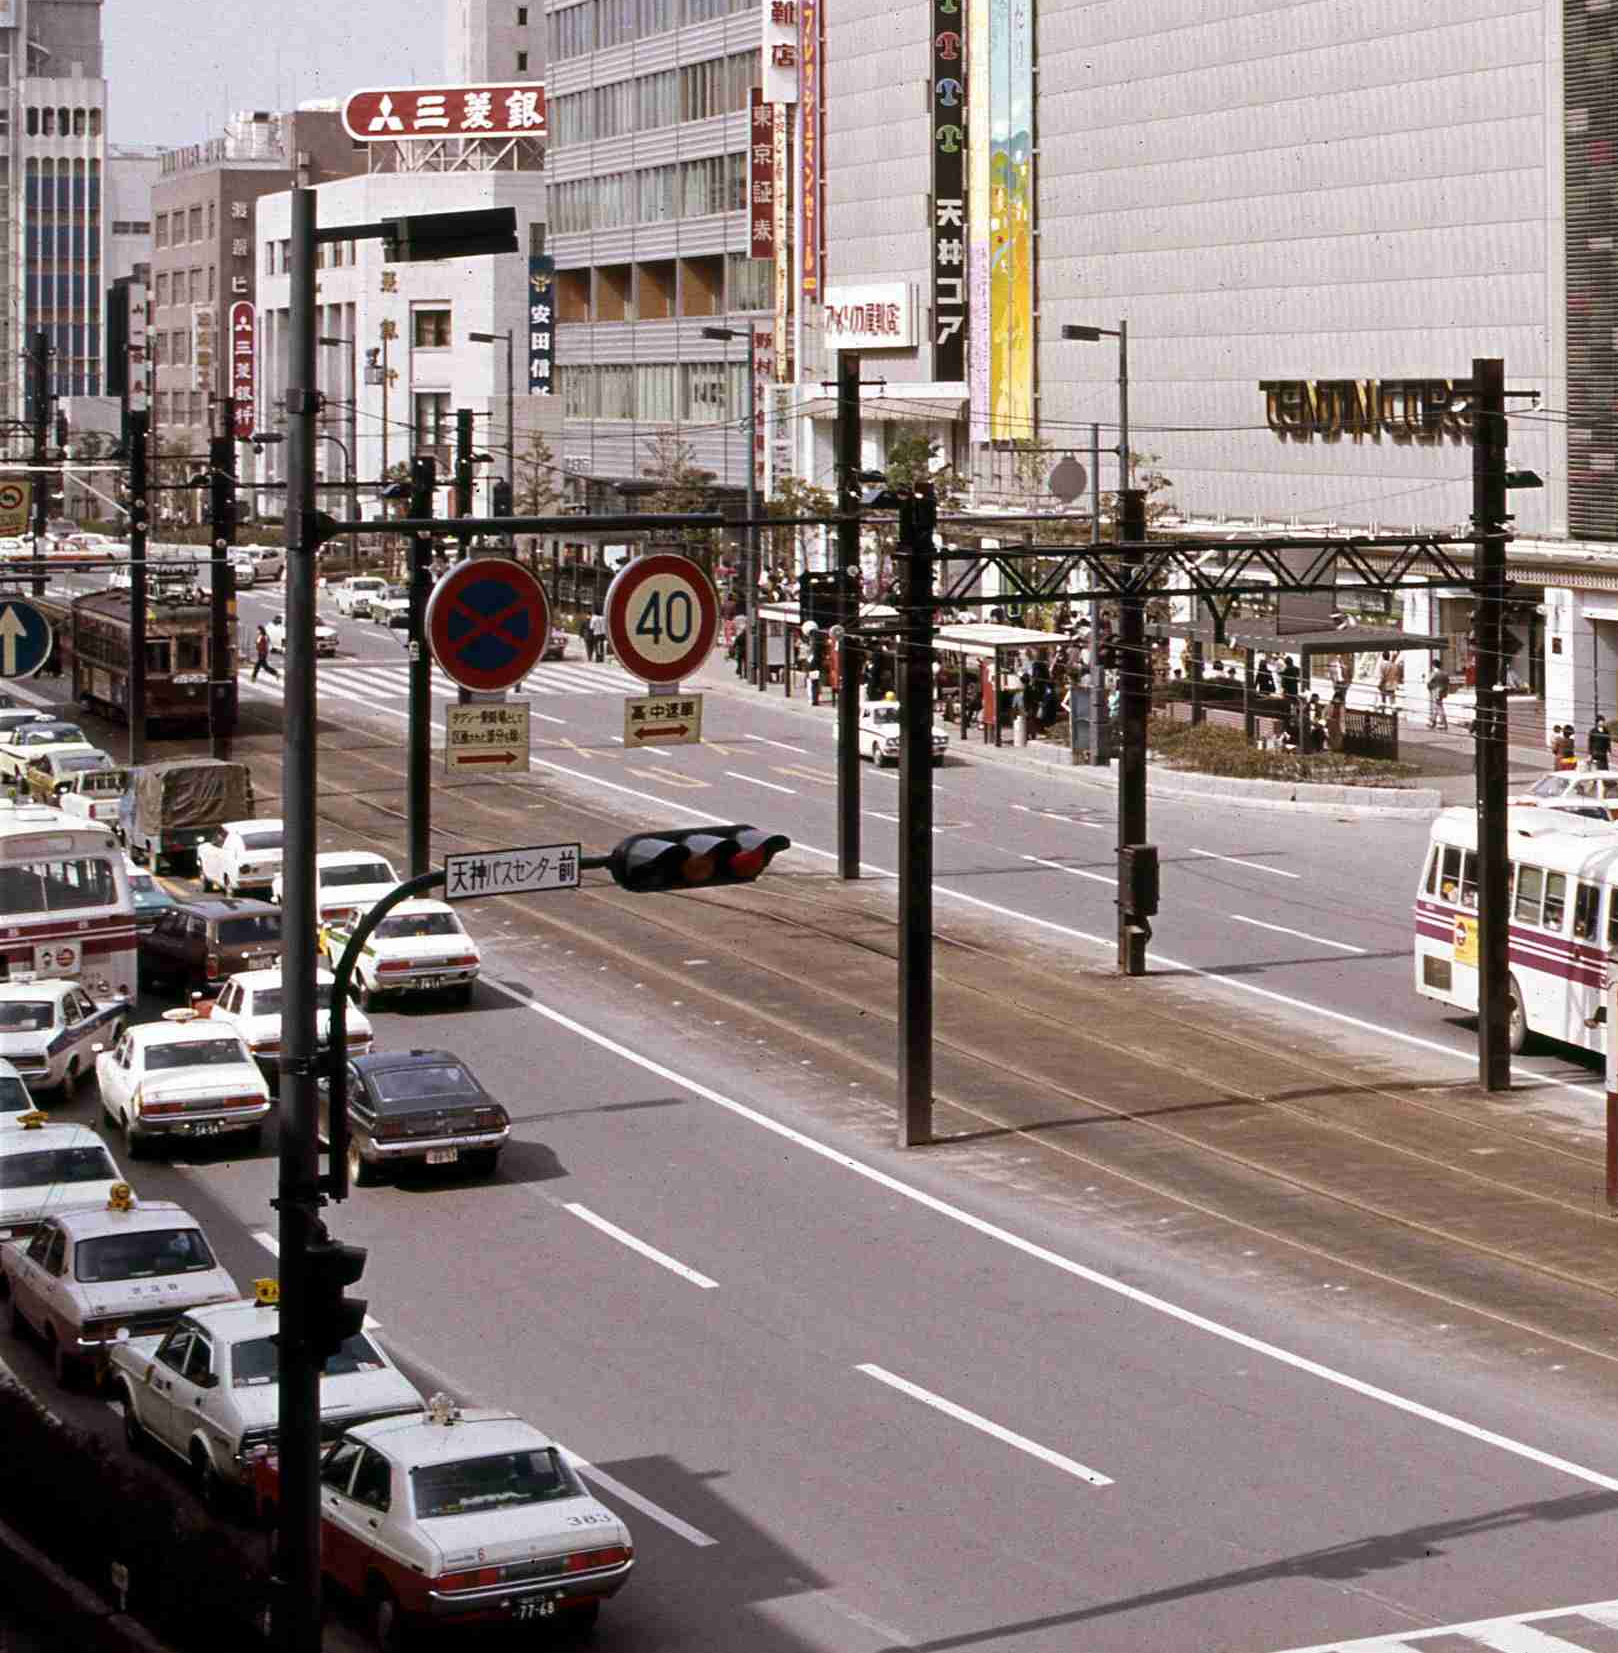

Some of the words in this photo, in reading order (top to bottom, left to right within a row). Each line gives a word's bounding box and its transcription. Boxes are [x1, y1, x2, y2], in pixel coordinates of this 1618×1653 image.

[413, 91, 545, 130] 三菱銀
[936, 198, 963, 345] 天神コア
[635, 589, 694, 646] 40
[451, 849, 576, 894] 天神バスセンター前
